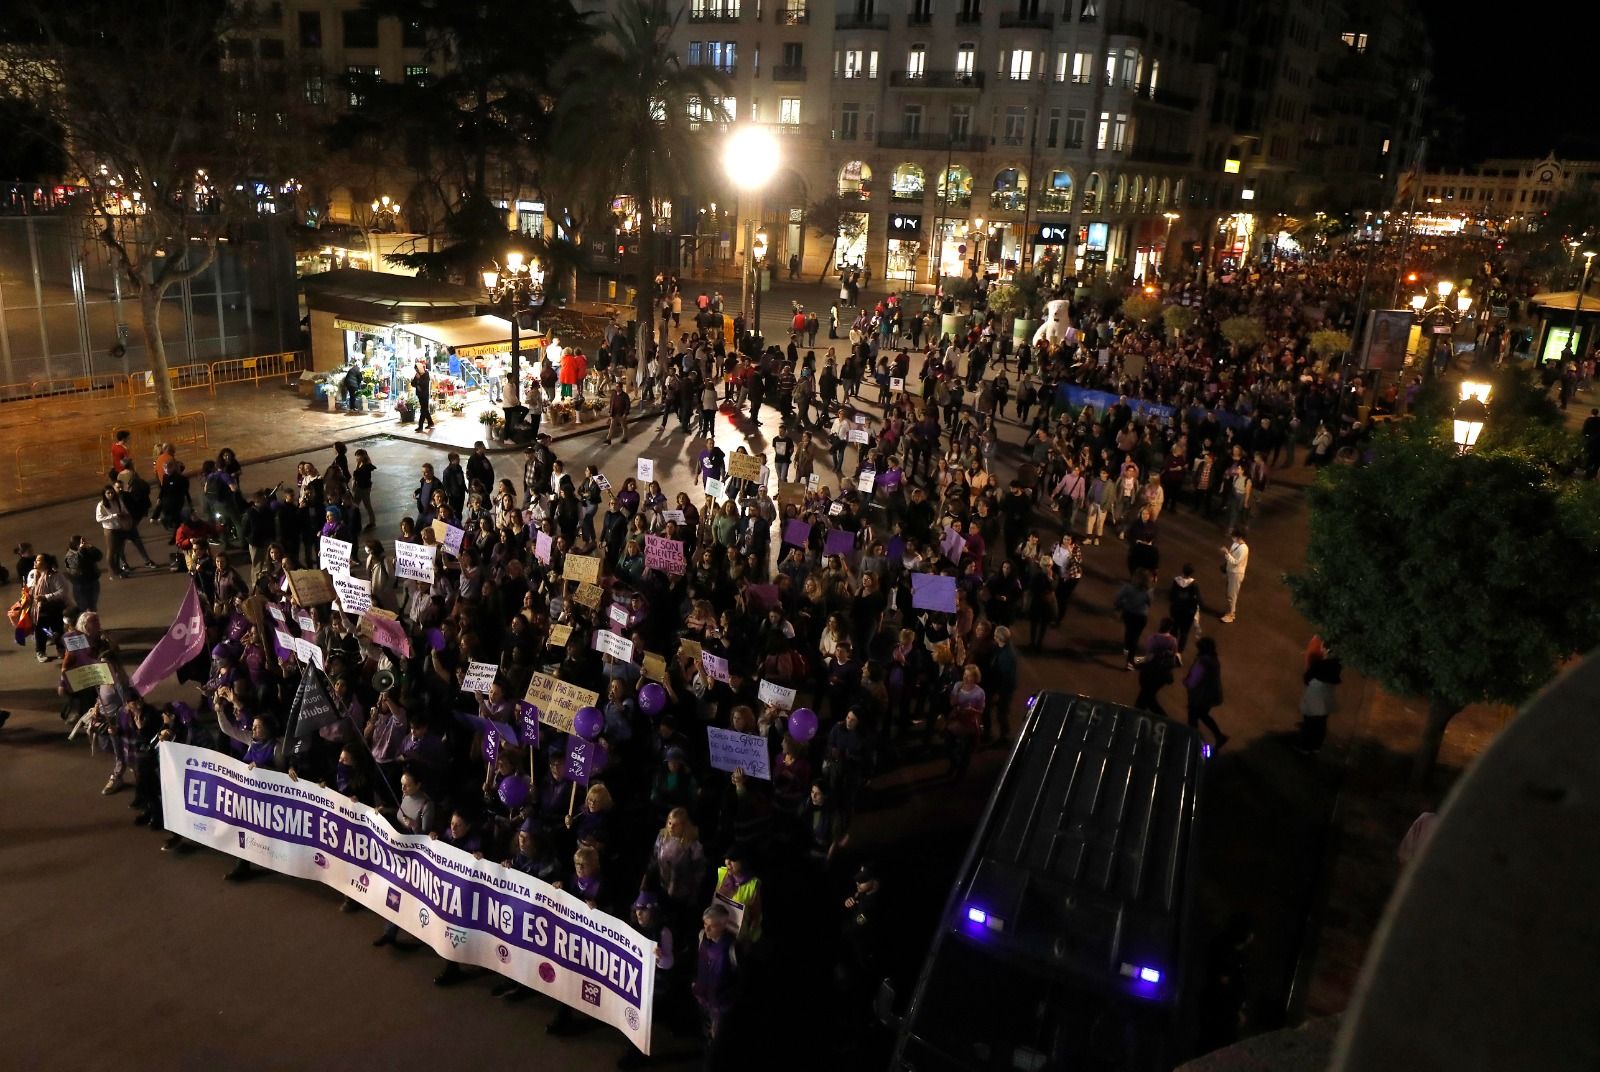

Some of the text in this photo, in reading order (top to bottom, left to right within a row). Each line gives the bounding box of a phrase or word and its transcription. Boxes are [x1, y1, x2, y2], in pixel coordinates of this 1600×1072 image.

[648, 537, 678, 552] NO SON
[399, 558, 415, 568] LUCHA
[201, 760, 335, 810] #ELFEMINISMONOVOTATRAIDORES
[535, 892, 630, 948] #FEMINISMOALPODER
[188, 778, 209, 809] EL
[216, 786, 313, 838] FEMINISME
[319, 811, 338, 849] ÉS
[344, 829, 462, 918] ABOLICIONISTA
[472, 892, 479, 921] I
[487, 898, 514, 934] NO
[522, 912, 548, 947] ES
[555, 927, 639, 998] RENDEIX
[445, 932, 467, 943] PFAC
